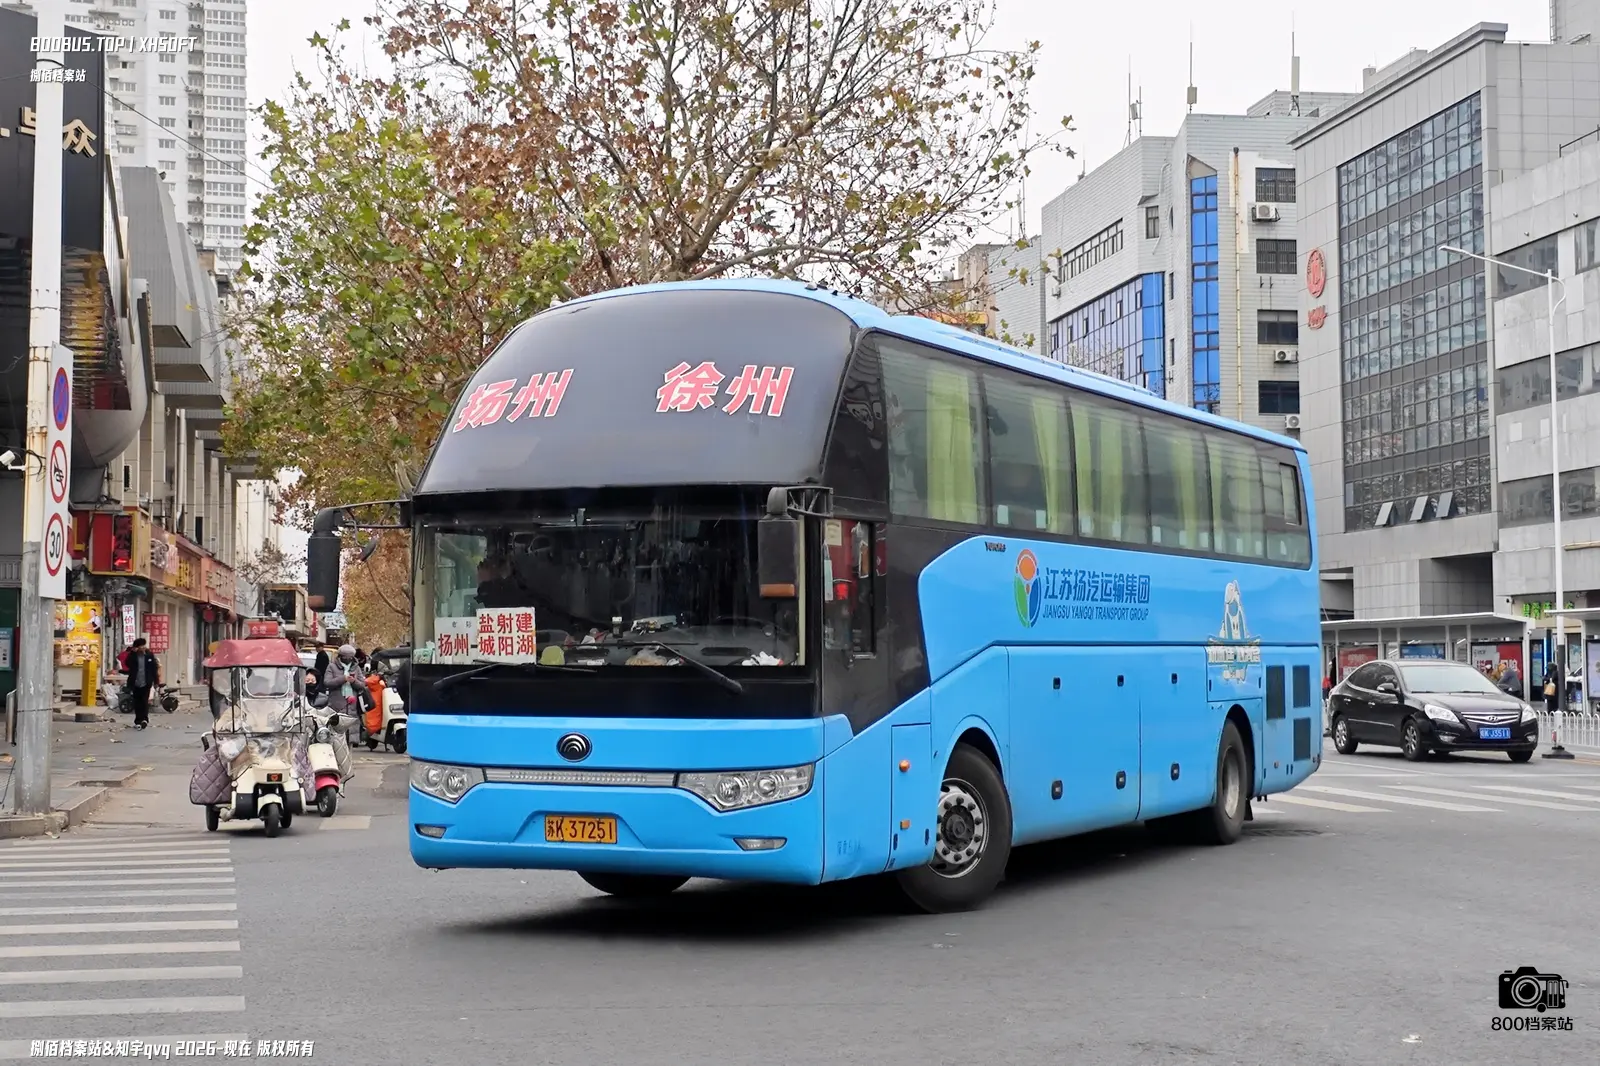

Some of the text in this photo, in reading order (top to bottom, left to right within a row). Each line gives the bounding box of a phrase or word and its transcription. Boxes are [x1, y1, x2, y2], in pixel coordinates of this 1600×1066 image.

[453, 361, 795, 433] 扬州 徐州
[49, 530, 62, 559] 30
[1043, 566, 1151, 604] 江苏扬汽运输集团
[123, 606, 135, 644] 平价超市
[1042, 604, 1150, 621] JIANGSU YANGQI TRANSPORT GROUP
